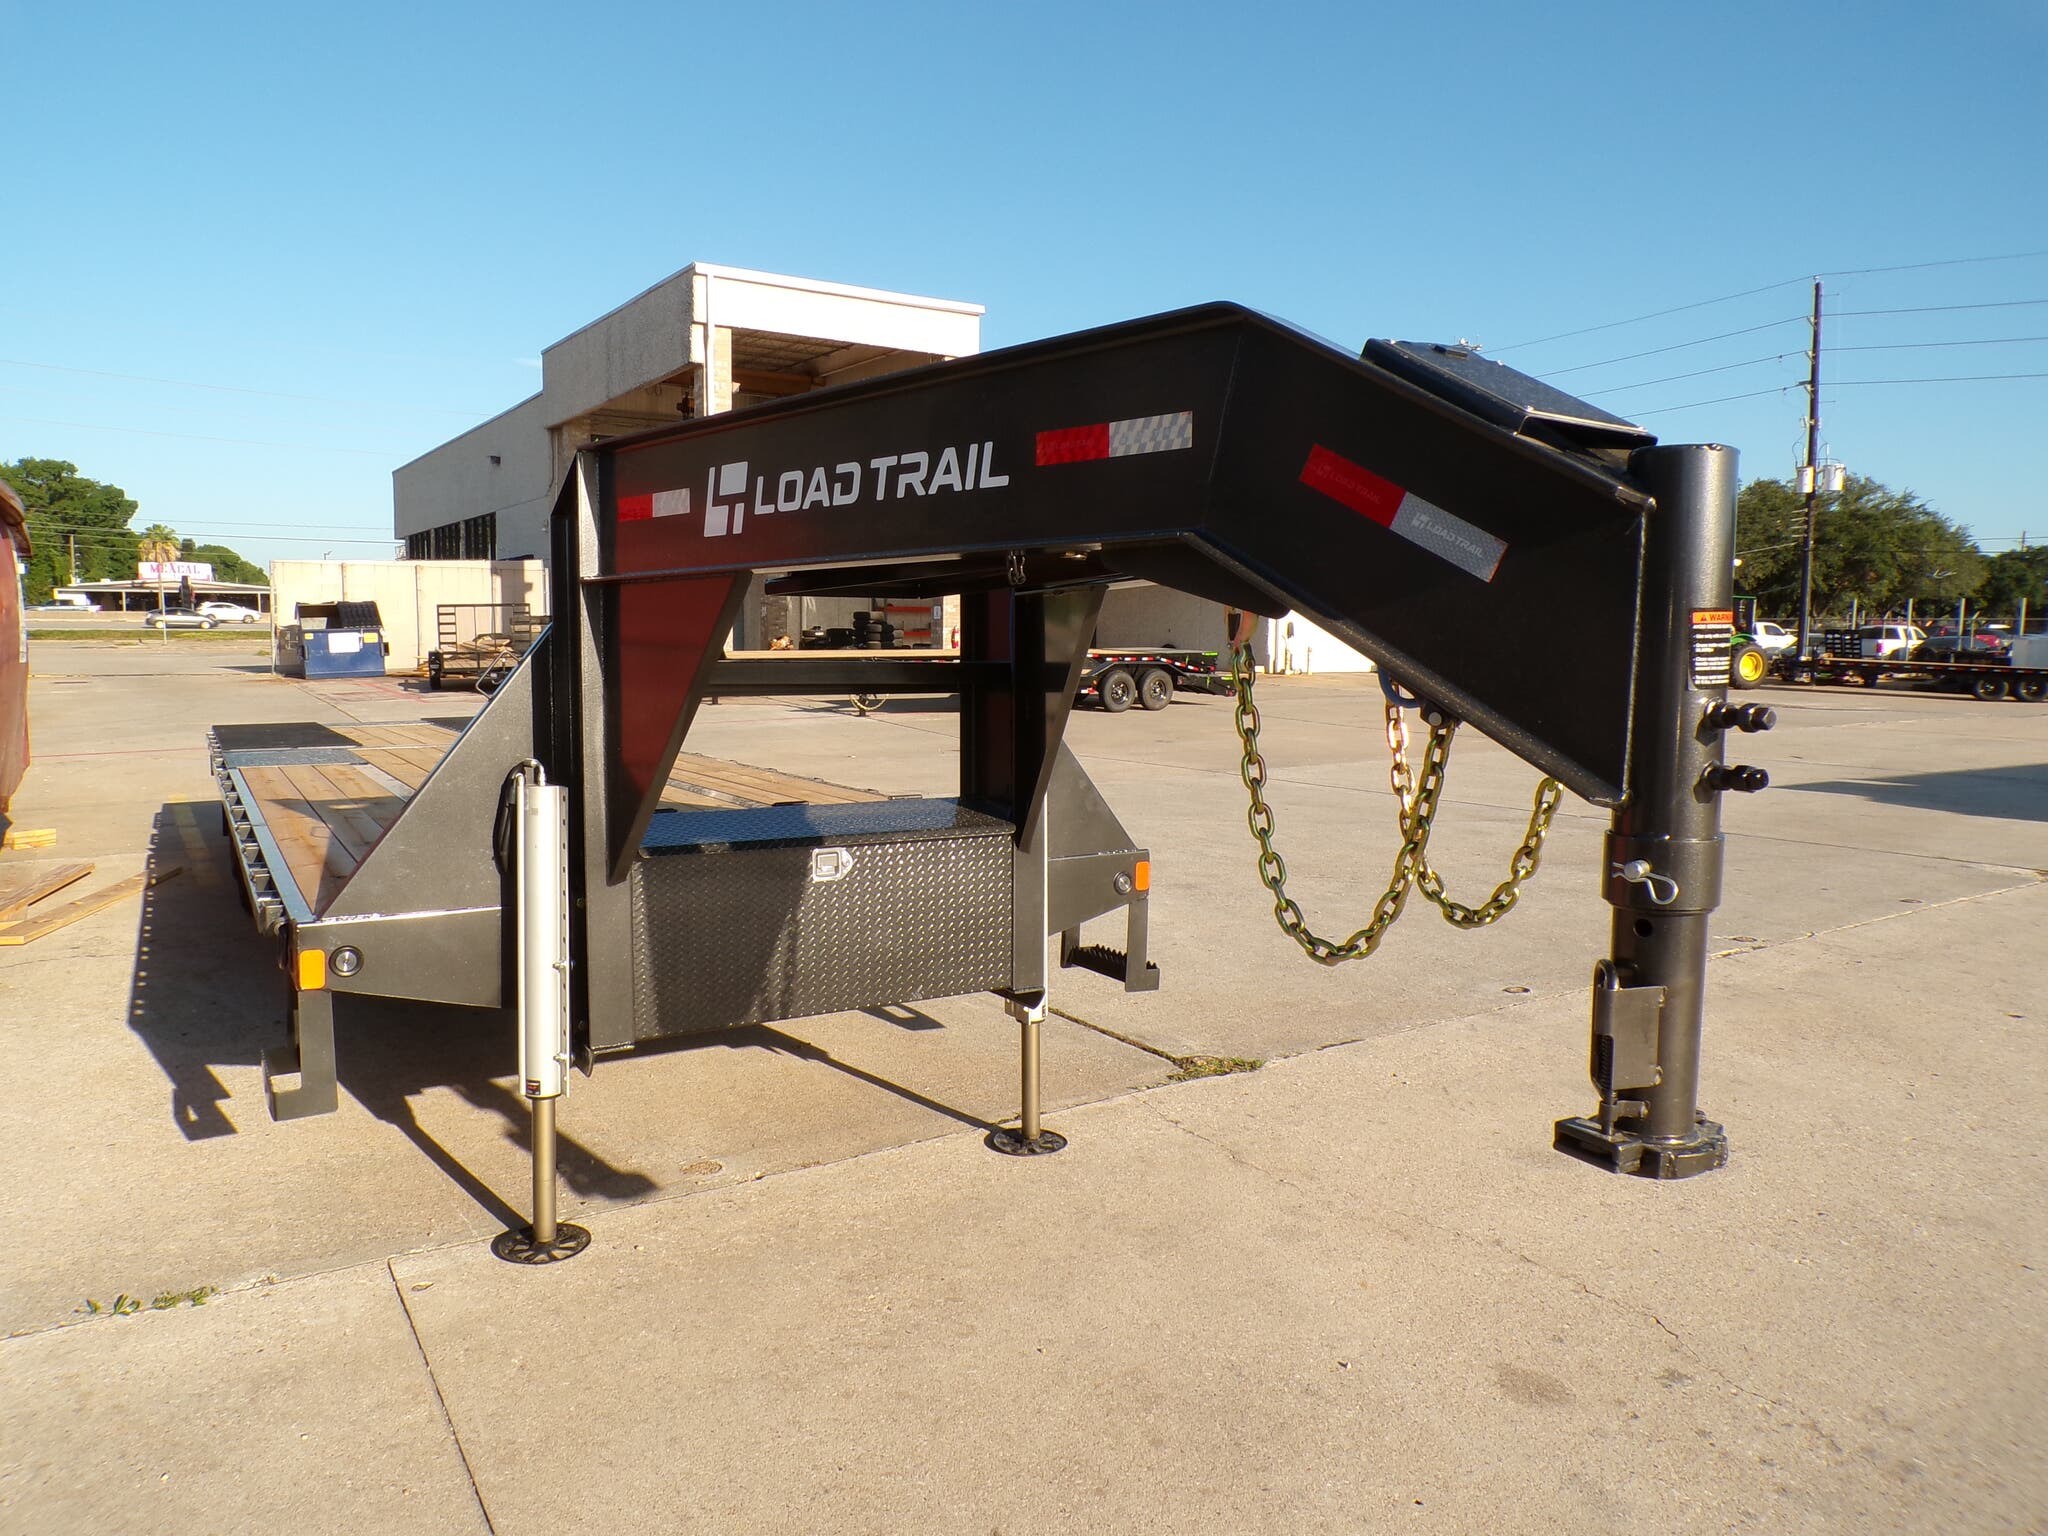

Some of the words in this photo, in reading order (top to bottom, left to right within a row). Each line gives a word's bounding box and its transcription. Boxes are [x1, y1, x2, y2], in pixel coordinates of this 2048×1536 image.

[754, 461, 862, 515] LOAD
[870, 441, 1010, 500] TRAIL
[1427, 521, 1457, 541] LOAD
[1456, 536, 1483, 557] TRAIL
